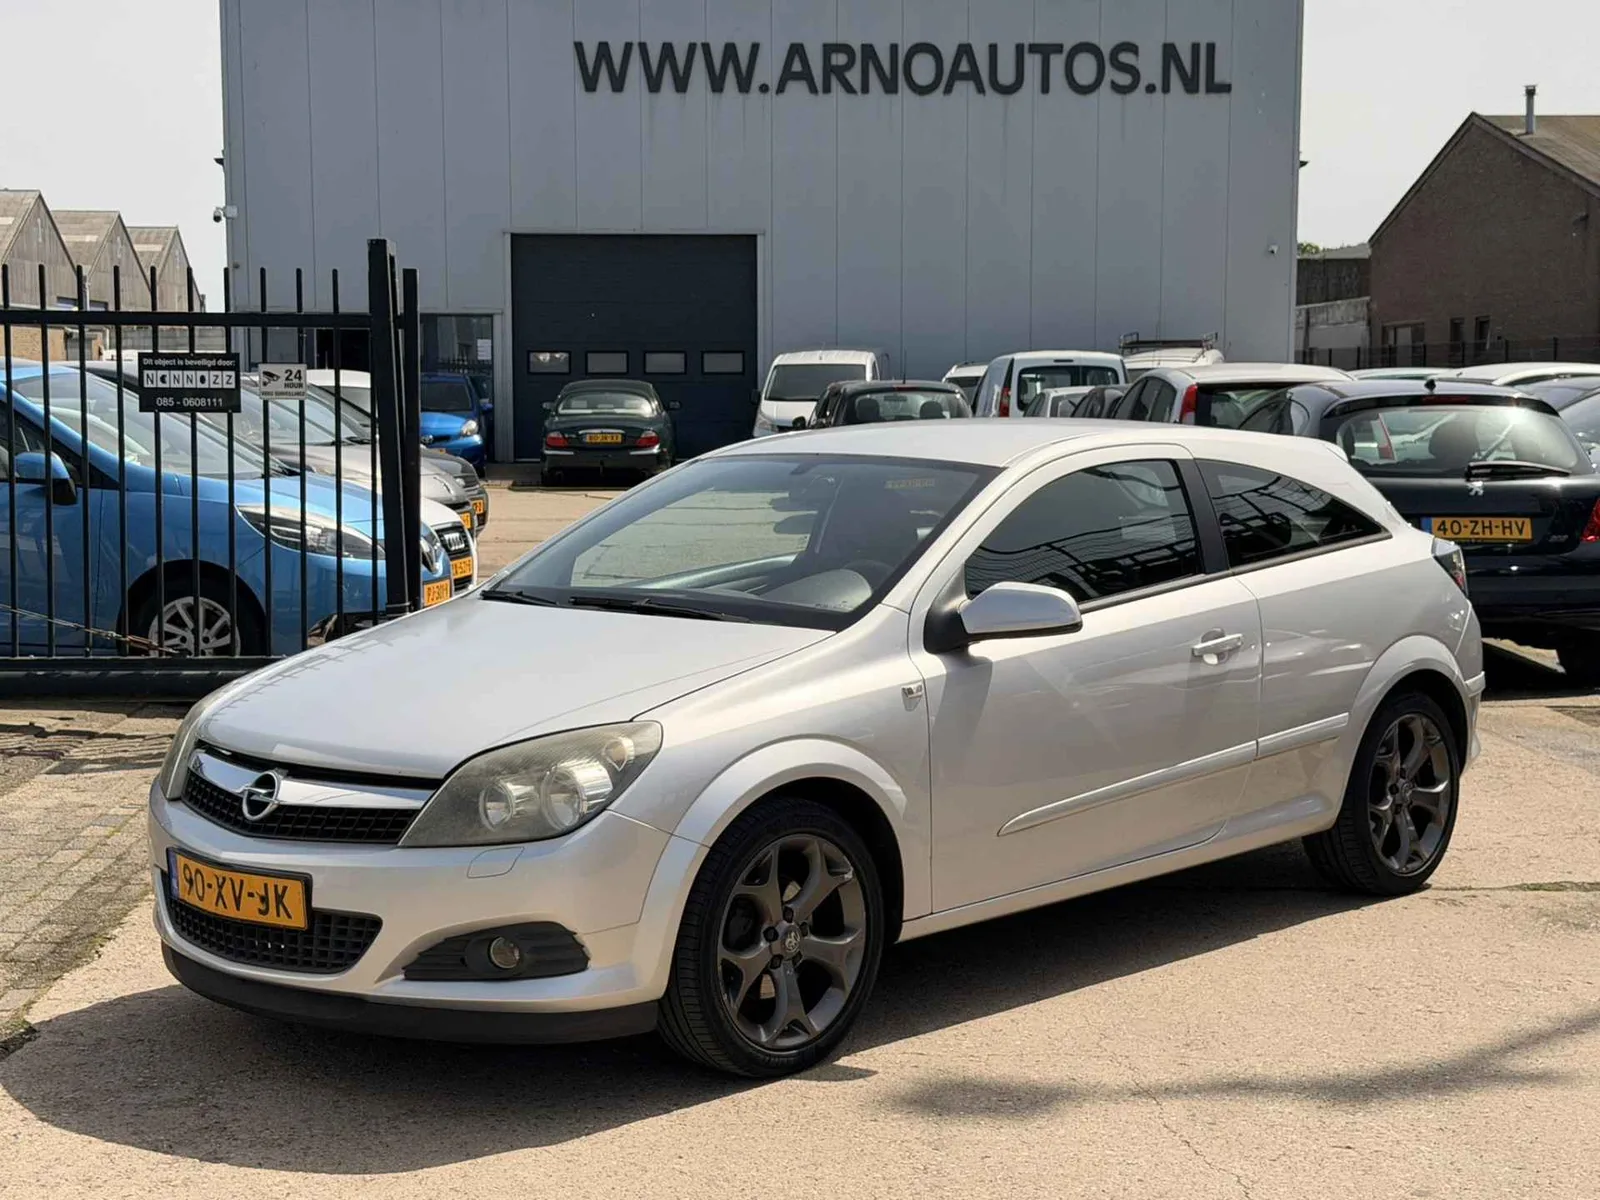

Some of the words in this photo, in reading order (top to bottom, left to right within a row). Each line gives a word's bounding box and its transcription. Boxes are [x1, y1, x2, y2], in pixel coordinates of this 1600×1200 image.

[573, 41, 1232, 96] WWW.ARNOAUTOS.NL
[154, 358, 177, 367] object
[177, 358, 184, 366] is
[184, 358, 216, 367] beveiligd
[217, 358, 236, 366] door:
[284, 369, 302, 381] 24
[156, 397, 174, 407] 085
[182, 397, 223, 407] 0608111
[1437, 519, 1525, 536] 40-ZH-HV
[182, 863, 293, 920] 90-XV-JK
